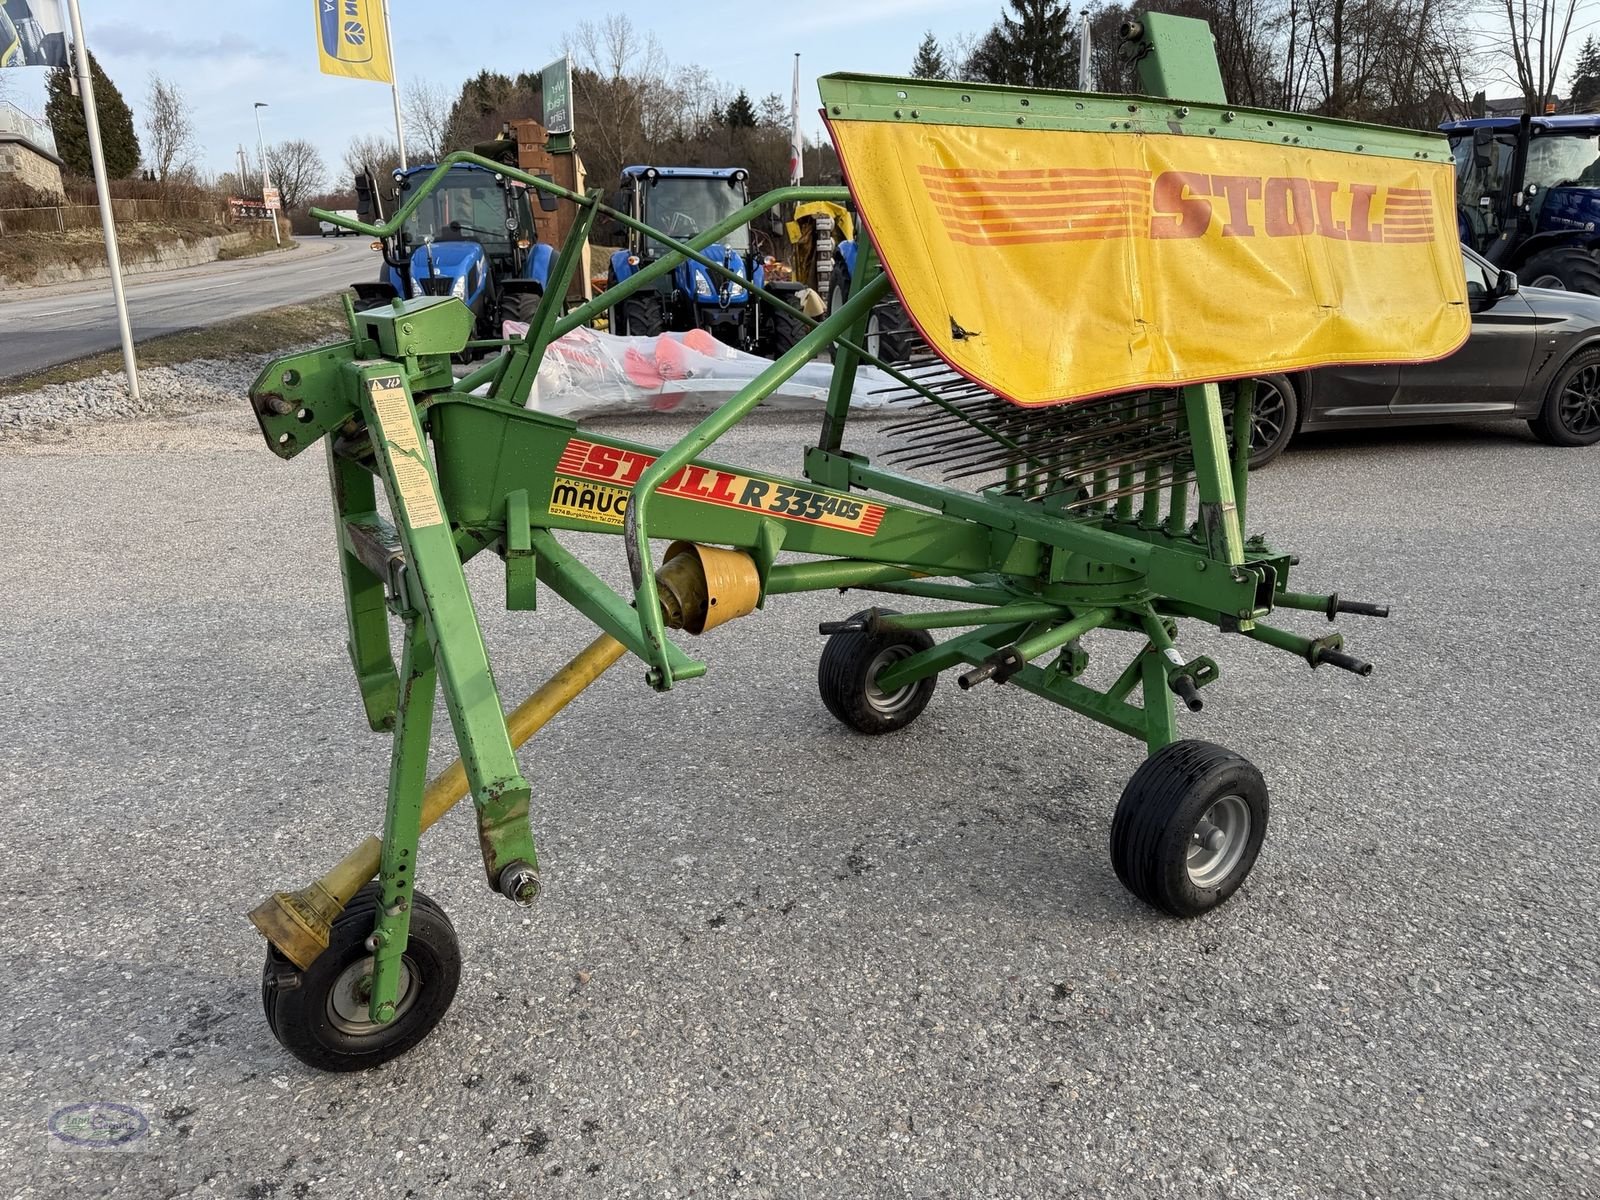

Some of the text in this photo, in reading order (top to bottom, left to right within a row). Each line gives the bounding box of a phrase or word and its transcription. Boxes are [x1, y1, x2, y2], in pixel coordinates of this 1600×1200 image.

[1150, 171, 1383, 243] STOLL
[552, 484, 629, 516] MAUC
[556, 477, 630, 496] FACHBETRI
[738, 479, 770, 508] R
